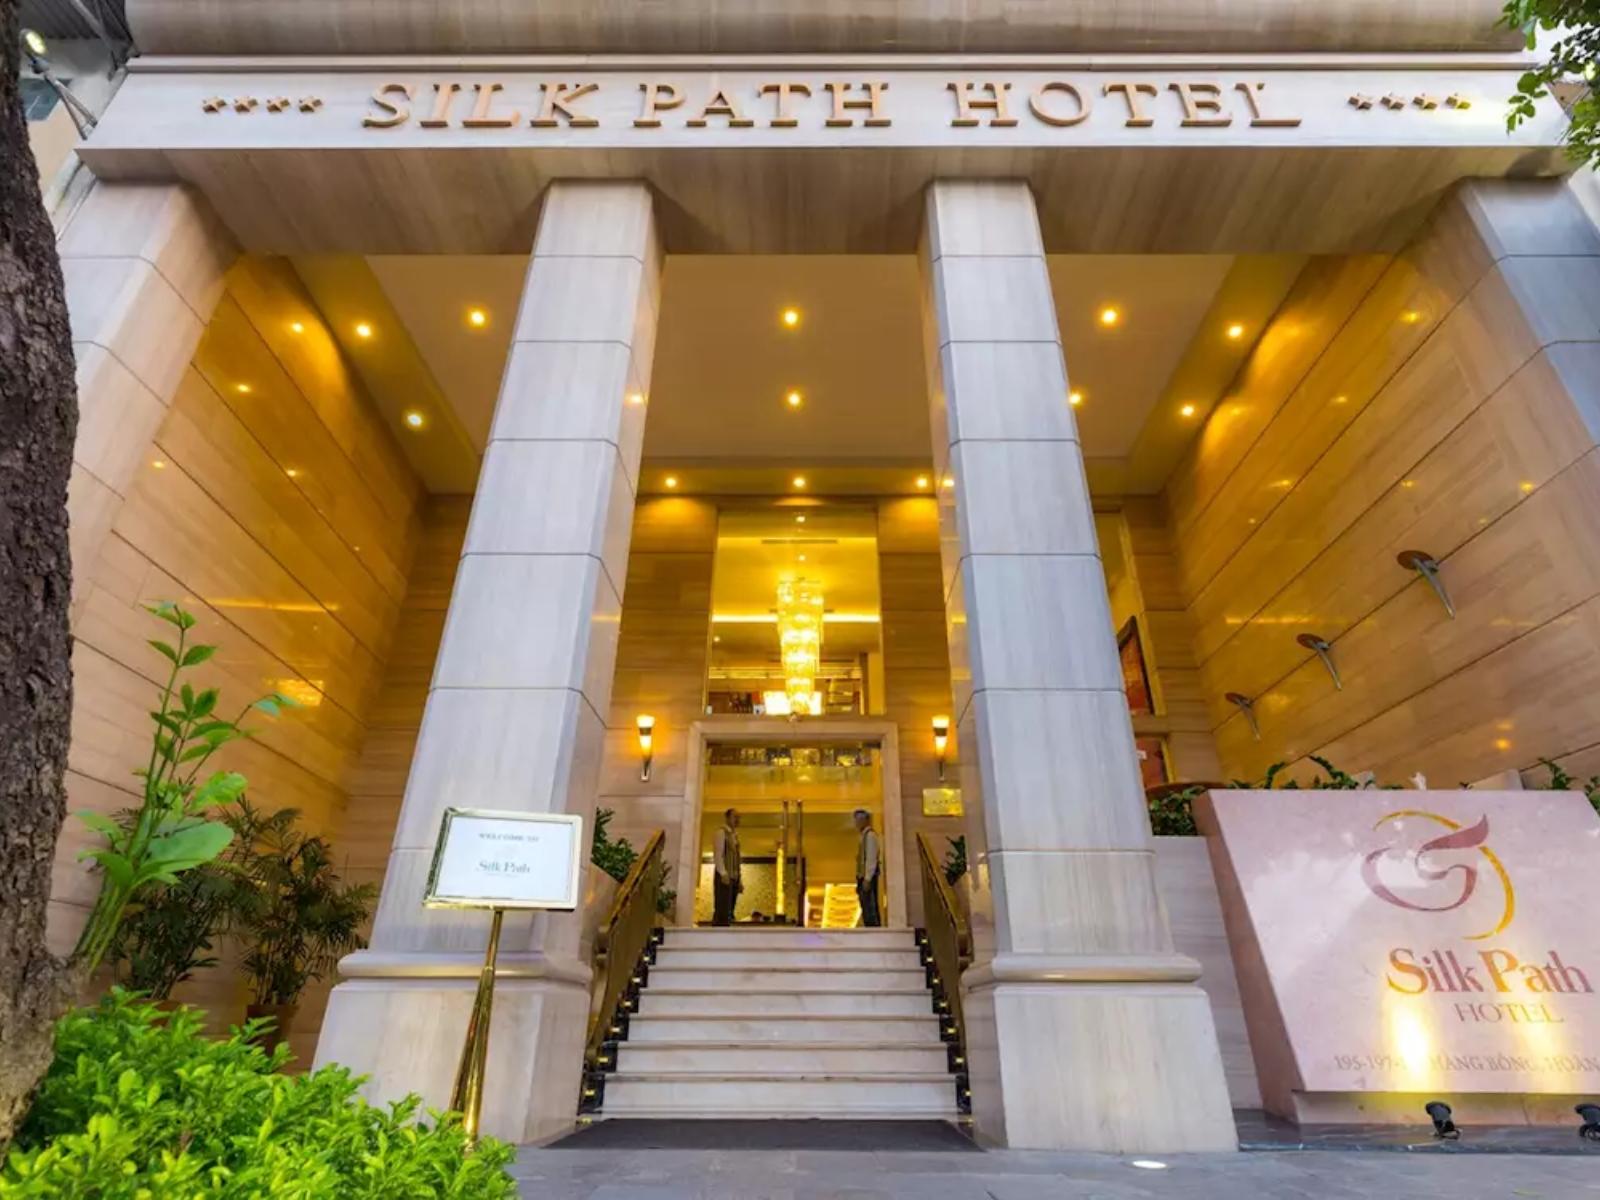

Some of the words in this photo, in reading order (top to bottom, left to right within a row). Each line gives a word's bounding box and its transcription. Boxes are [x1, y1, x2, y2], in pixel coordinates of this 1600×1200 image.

[363, 82, 600, 128] SILK
[633, 82, 892, 128] PATH
[946, 82, 1302, 128] HOTEL
[478, 860, 500, 872] Silk
[1387, 949, 1483, 994] Silk
[1478, 950, 1595, 993] Path
[1455, 1002, 1565, 1024] HOTEL
